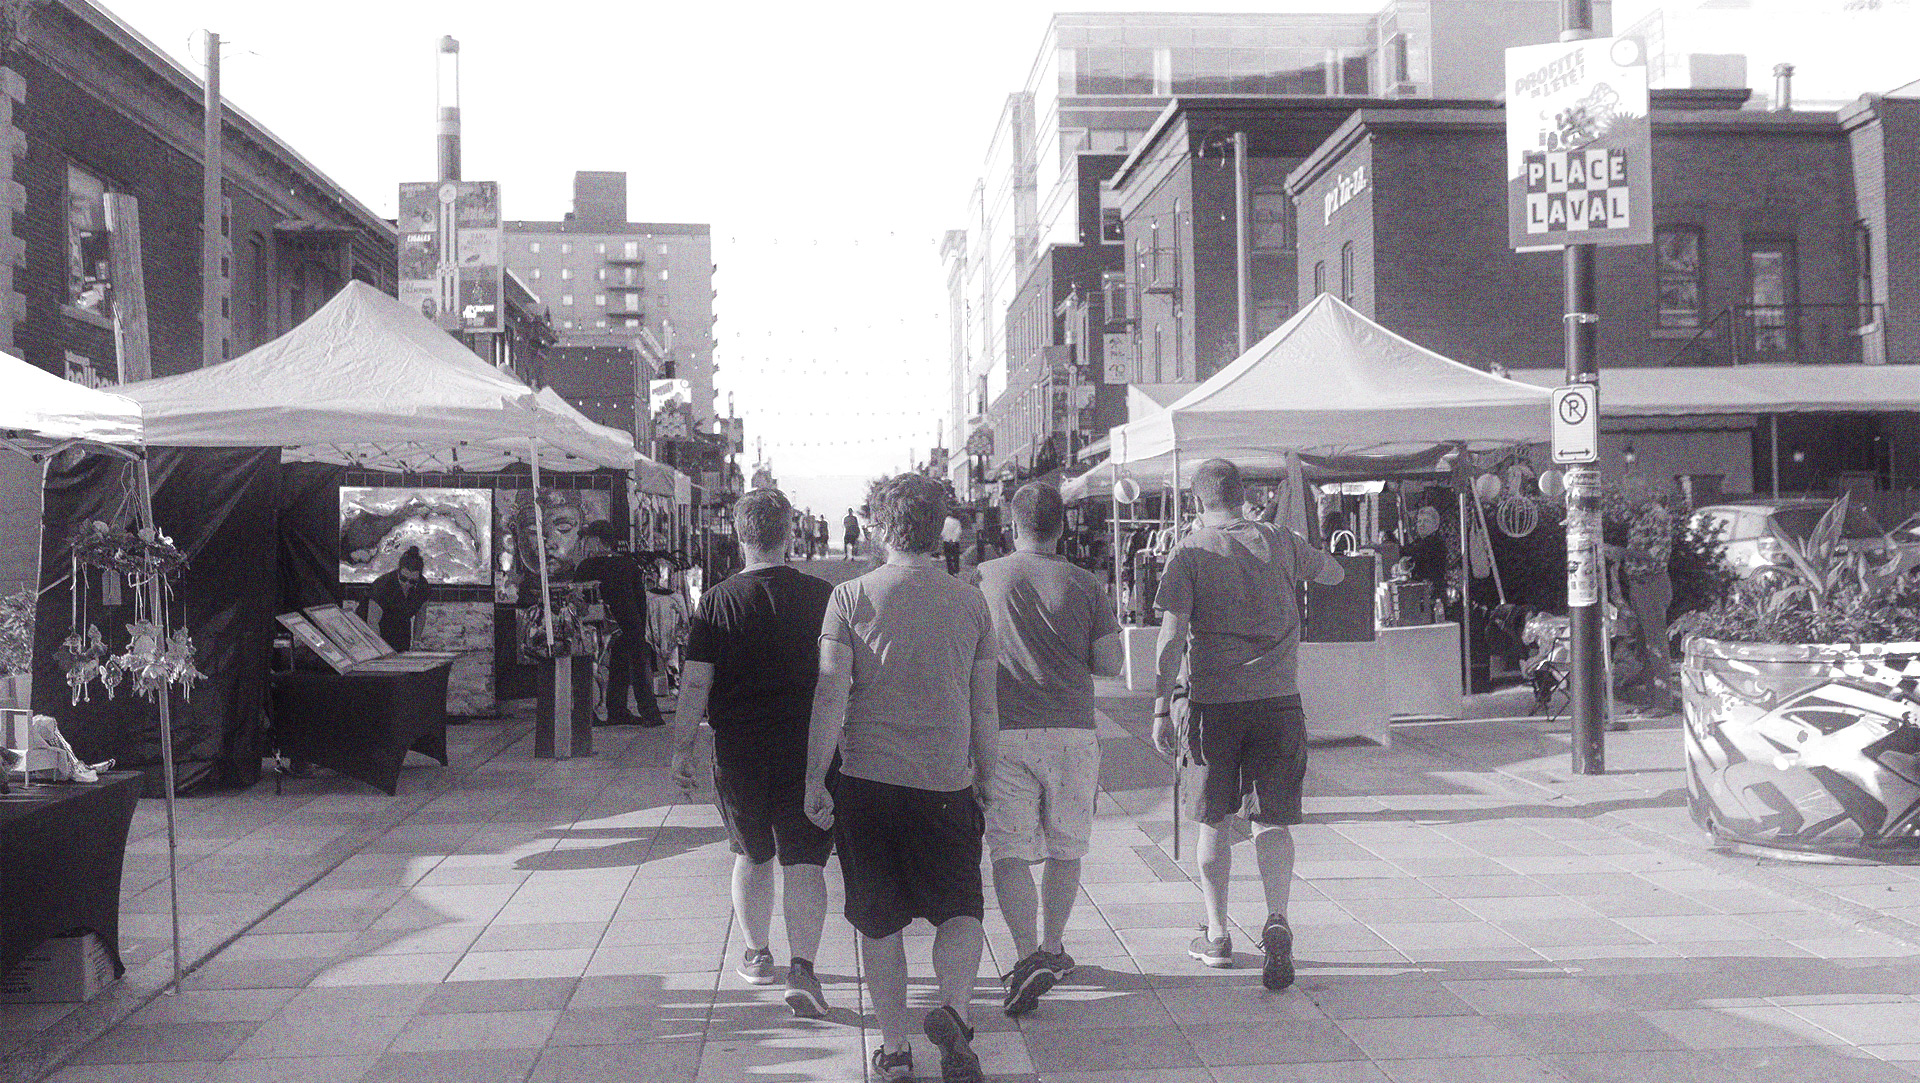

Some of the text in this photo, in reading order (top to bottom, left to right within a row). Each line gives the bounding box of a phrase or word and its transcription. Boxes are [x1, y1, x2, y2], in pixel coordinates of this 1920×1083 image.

[1515, 47, 1585, 96] PROFITE
[1528, 156, 1626, 187] PLACE
[1531, 196, 1625, 224] LAVAL
